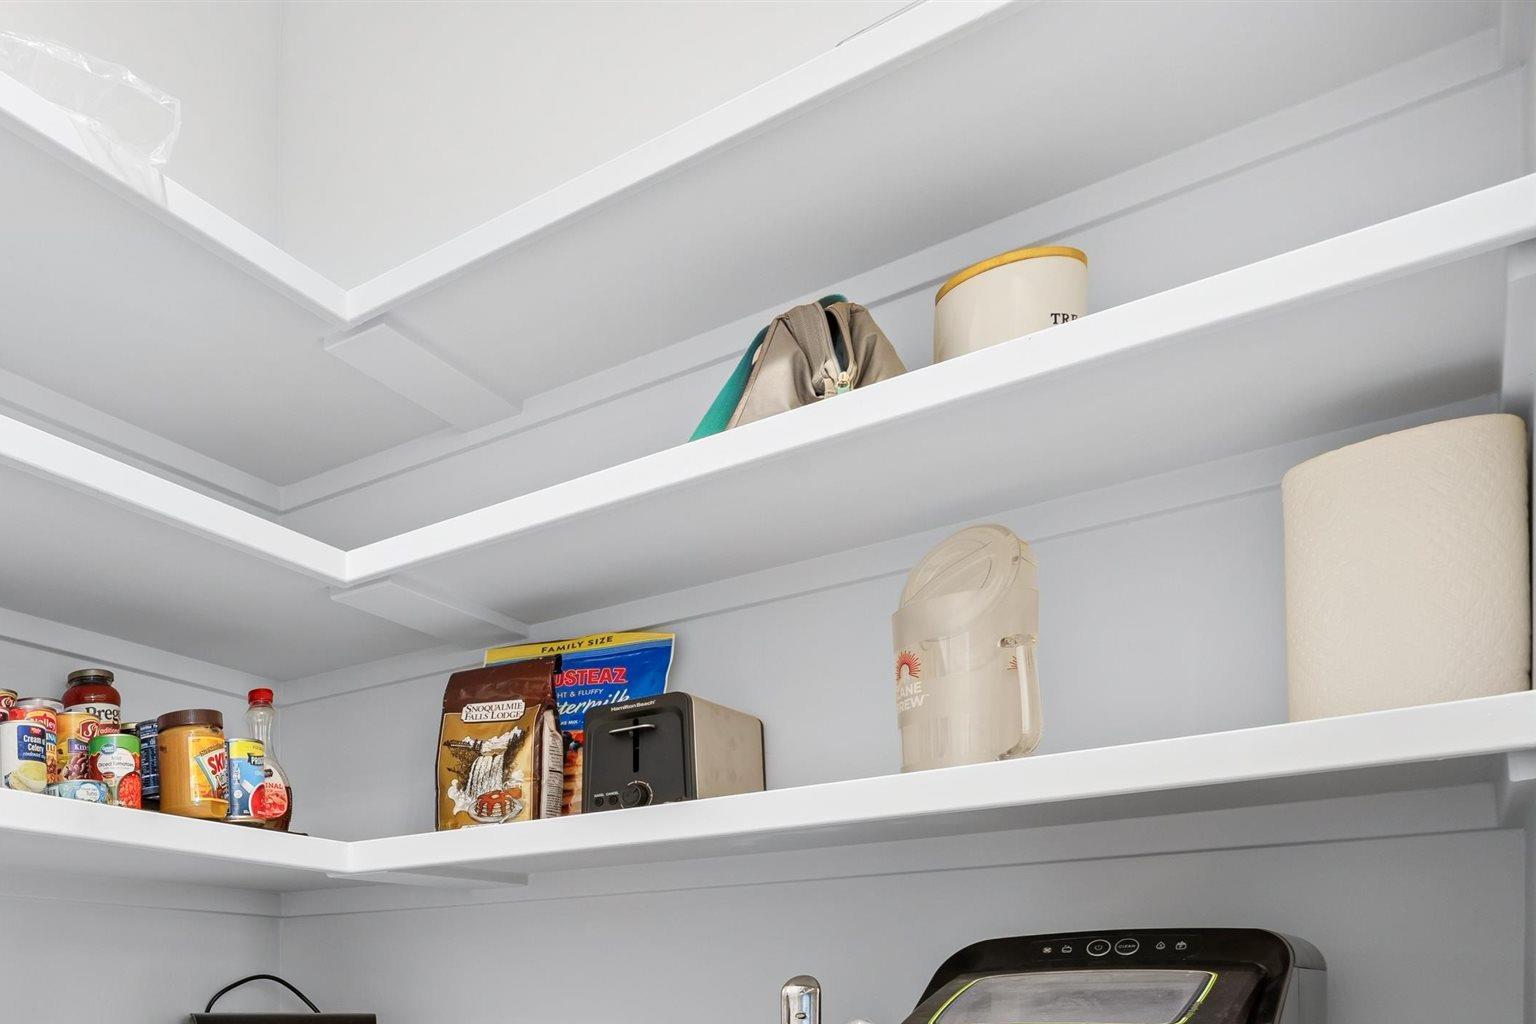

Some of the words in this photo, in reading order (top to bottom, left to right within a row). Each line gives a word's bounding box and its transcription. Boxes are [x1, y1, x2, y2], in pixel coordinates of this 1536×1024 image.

[541, 640, 584, 654] FAMILY
[587, 635, 614, 646] SIZE
[577, 688, 605, 697] FLUFFY
[465, 701, 524, 714] SNOQUALMIE
[464, 711, 490, 722] FALLS
[490, 708, 523, 720] LODGE
[23, 735, 42, 743] Cream
[27, 743, 45, 753] Celery
